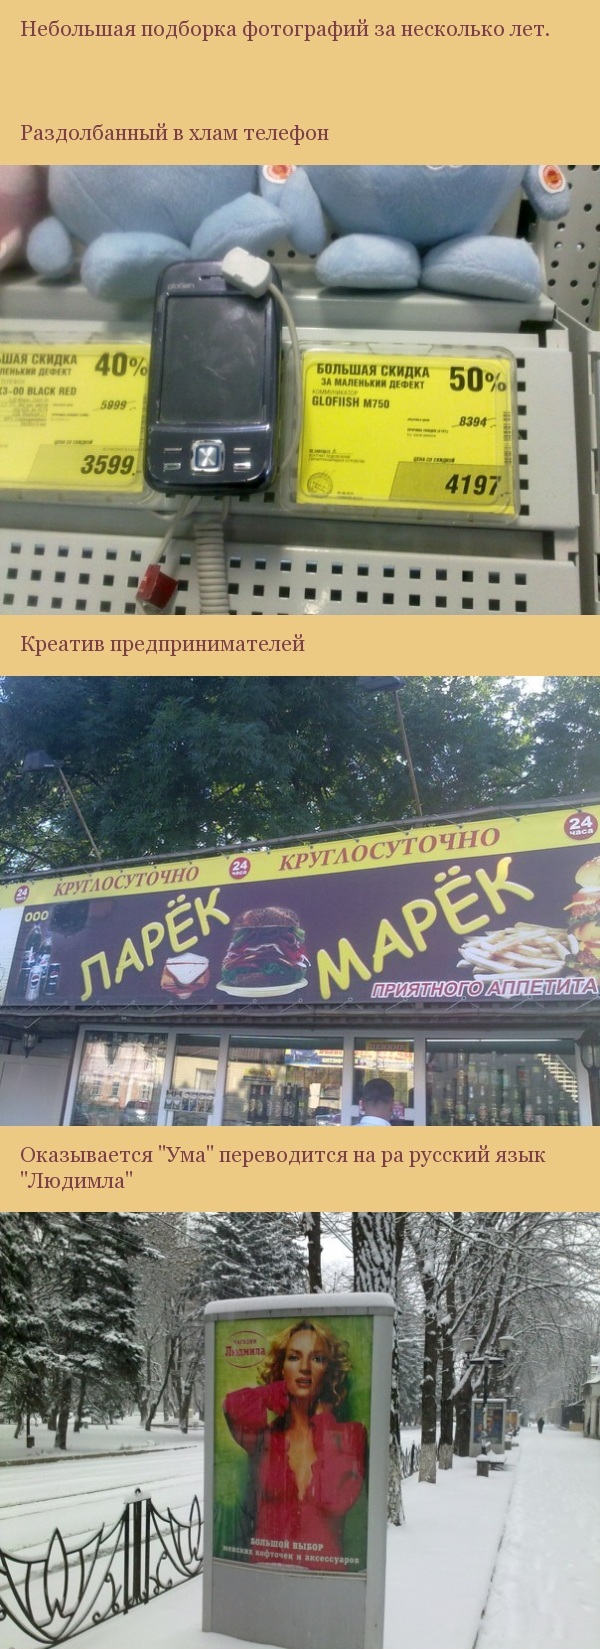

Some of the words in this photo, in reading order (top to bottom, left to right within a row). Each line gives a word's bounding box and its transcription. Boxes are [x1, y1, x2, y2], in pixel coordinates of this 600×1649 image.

[95, 352, 148, 377] 40%
[316, 363, 376, 377] БОЛЬШАЯ
[381, 364, 430, 378] СКИДКА
[449, 366, 508, 392] 50%
[321, 378, 332, 386] ЗА
[389, 380, 425, 390] ДЕФЕКТ
[27, 387, 56, 396] BLACK
[58, 387, 77, 396] RED
[363, 398, 390, 409] M750
[568, 815, 592, 829] 24
[278, 827, 501, 872] КРУГЛОСУТОЧНО
[232, 860, 248, 872] 24
[53, 866, 199, 897] КРУГЛОСУТОЧНО
[316, 856, 535, 1000] МАРЁК
[80, 887, 231, 1002] ЛАРЁК
[371, 978, 484, 999] ПРИЯТНОГО
[486, 976, 599, 997] АППЕТИТА
